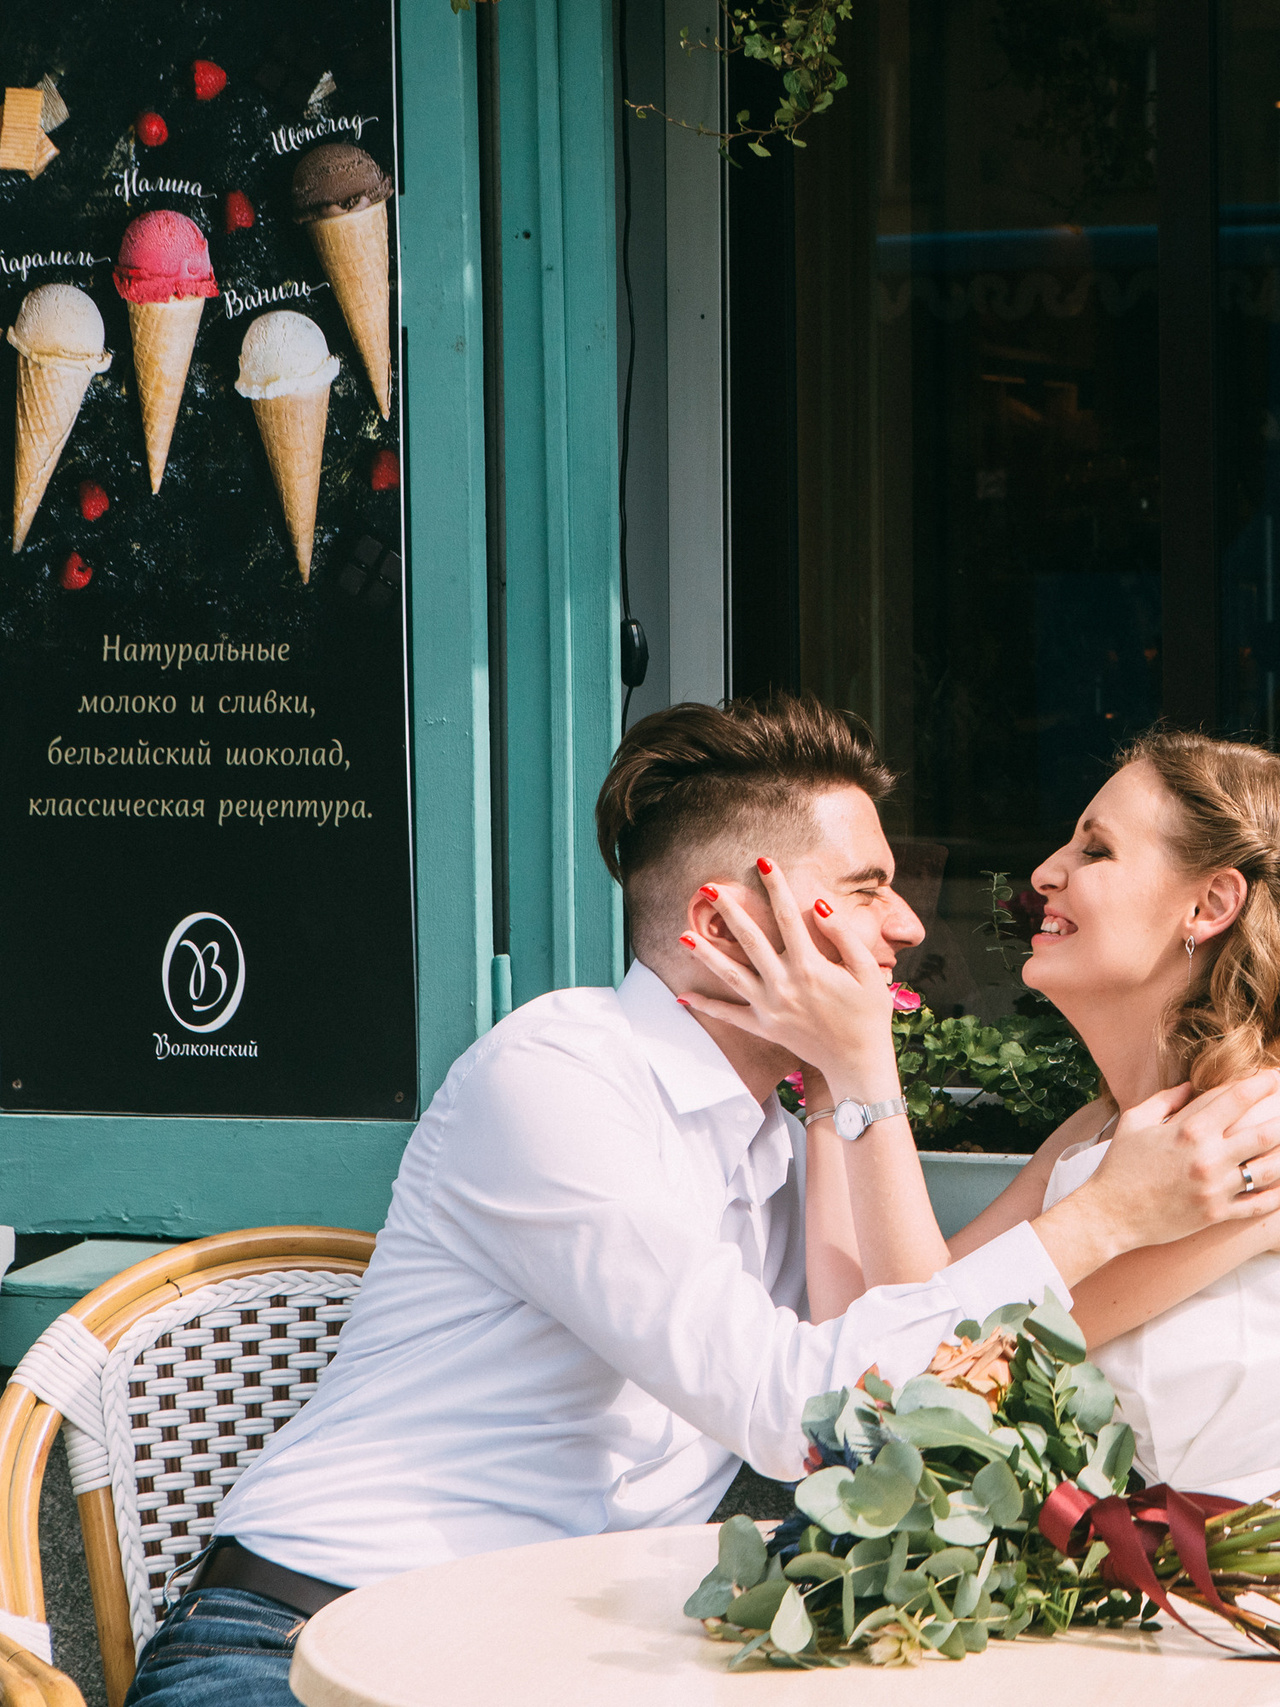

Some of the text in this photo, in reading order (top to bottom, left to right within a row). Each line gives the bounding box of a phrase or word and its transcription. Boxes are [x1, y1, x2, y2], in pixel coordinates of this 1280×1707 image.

[271, 114, 379, 156] Шоколад
[114, 168, 218, 204] Малина
[223, 281, 331, 320] Ваниль
[103, 634, 289, 670] Натуральные
[78, 690, 315, 717] молоко и сливки,
[48, 736, 349, 770] бельгийский шоколад,
[30, 799, 372, 827] классическая рецептура.
[153, 1032, 258, 1060] Волконский
